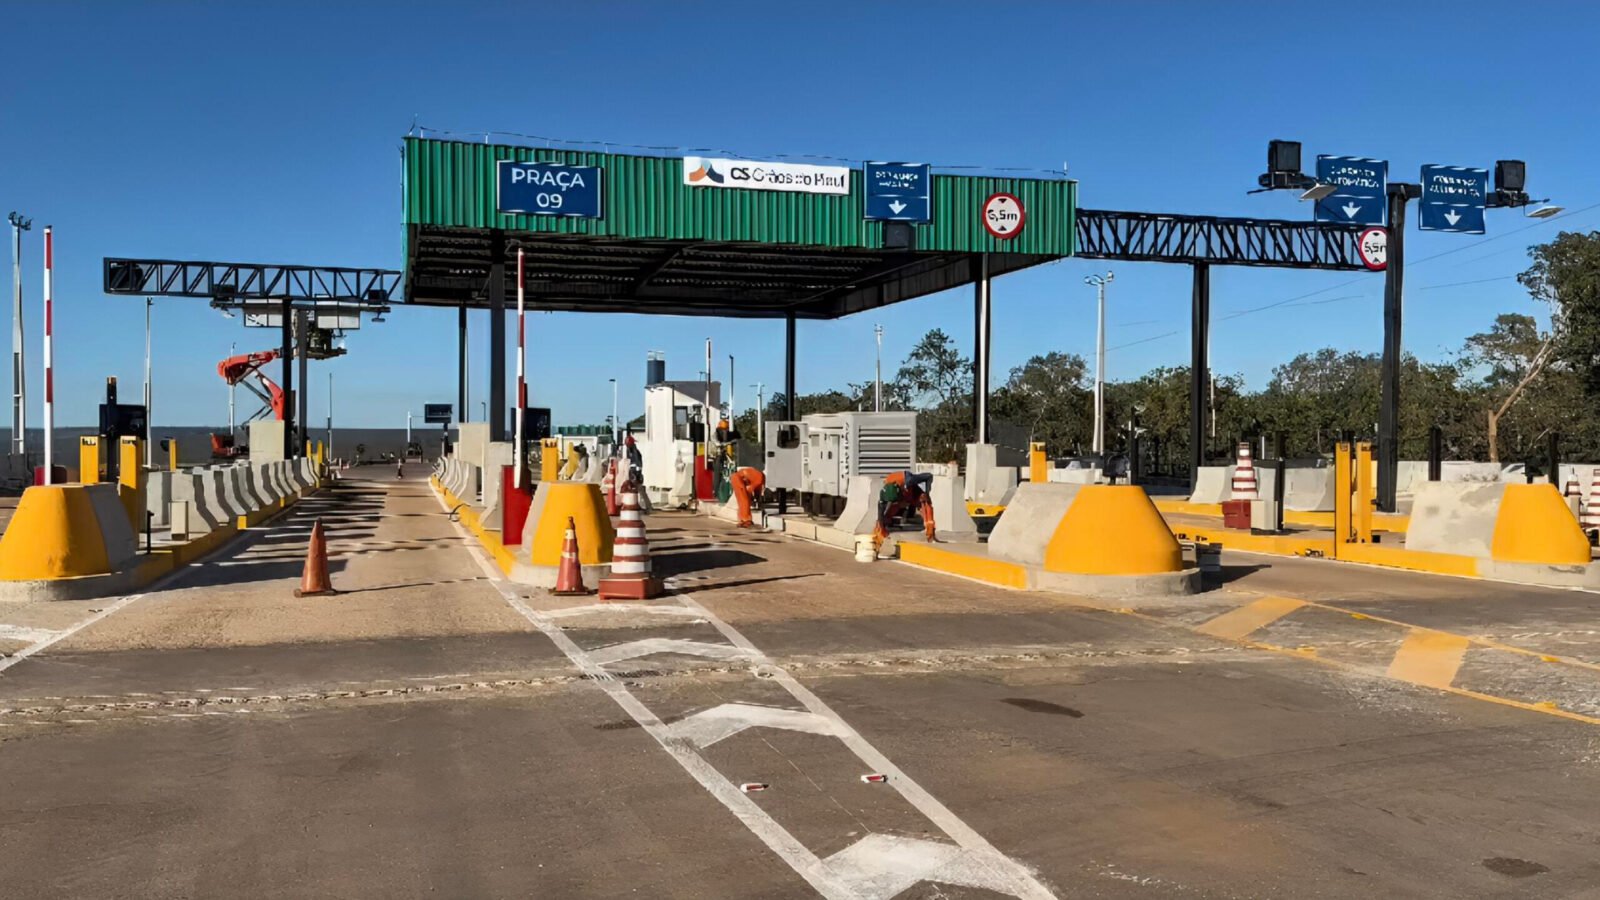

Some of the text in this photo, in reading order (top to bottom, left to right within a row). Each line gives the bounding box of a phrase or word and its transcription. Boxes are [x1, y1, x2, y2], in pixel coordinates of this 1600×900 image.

[511, 167, 586, 192] PRAÇA
[730, 167, 751, 181] CS
[536, 192, 563, 209] 09
